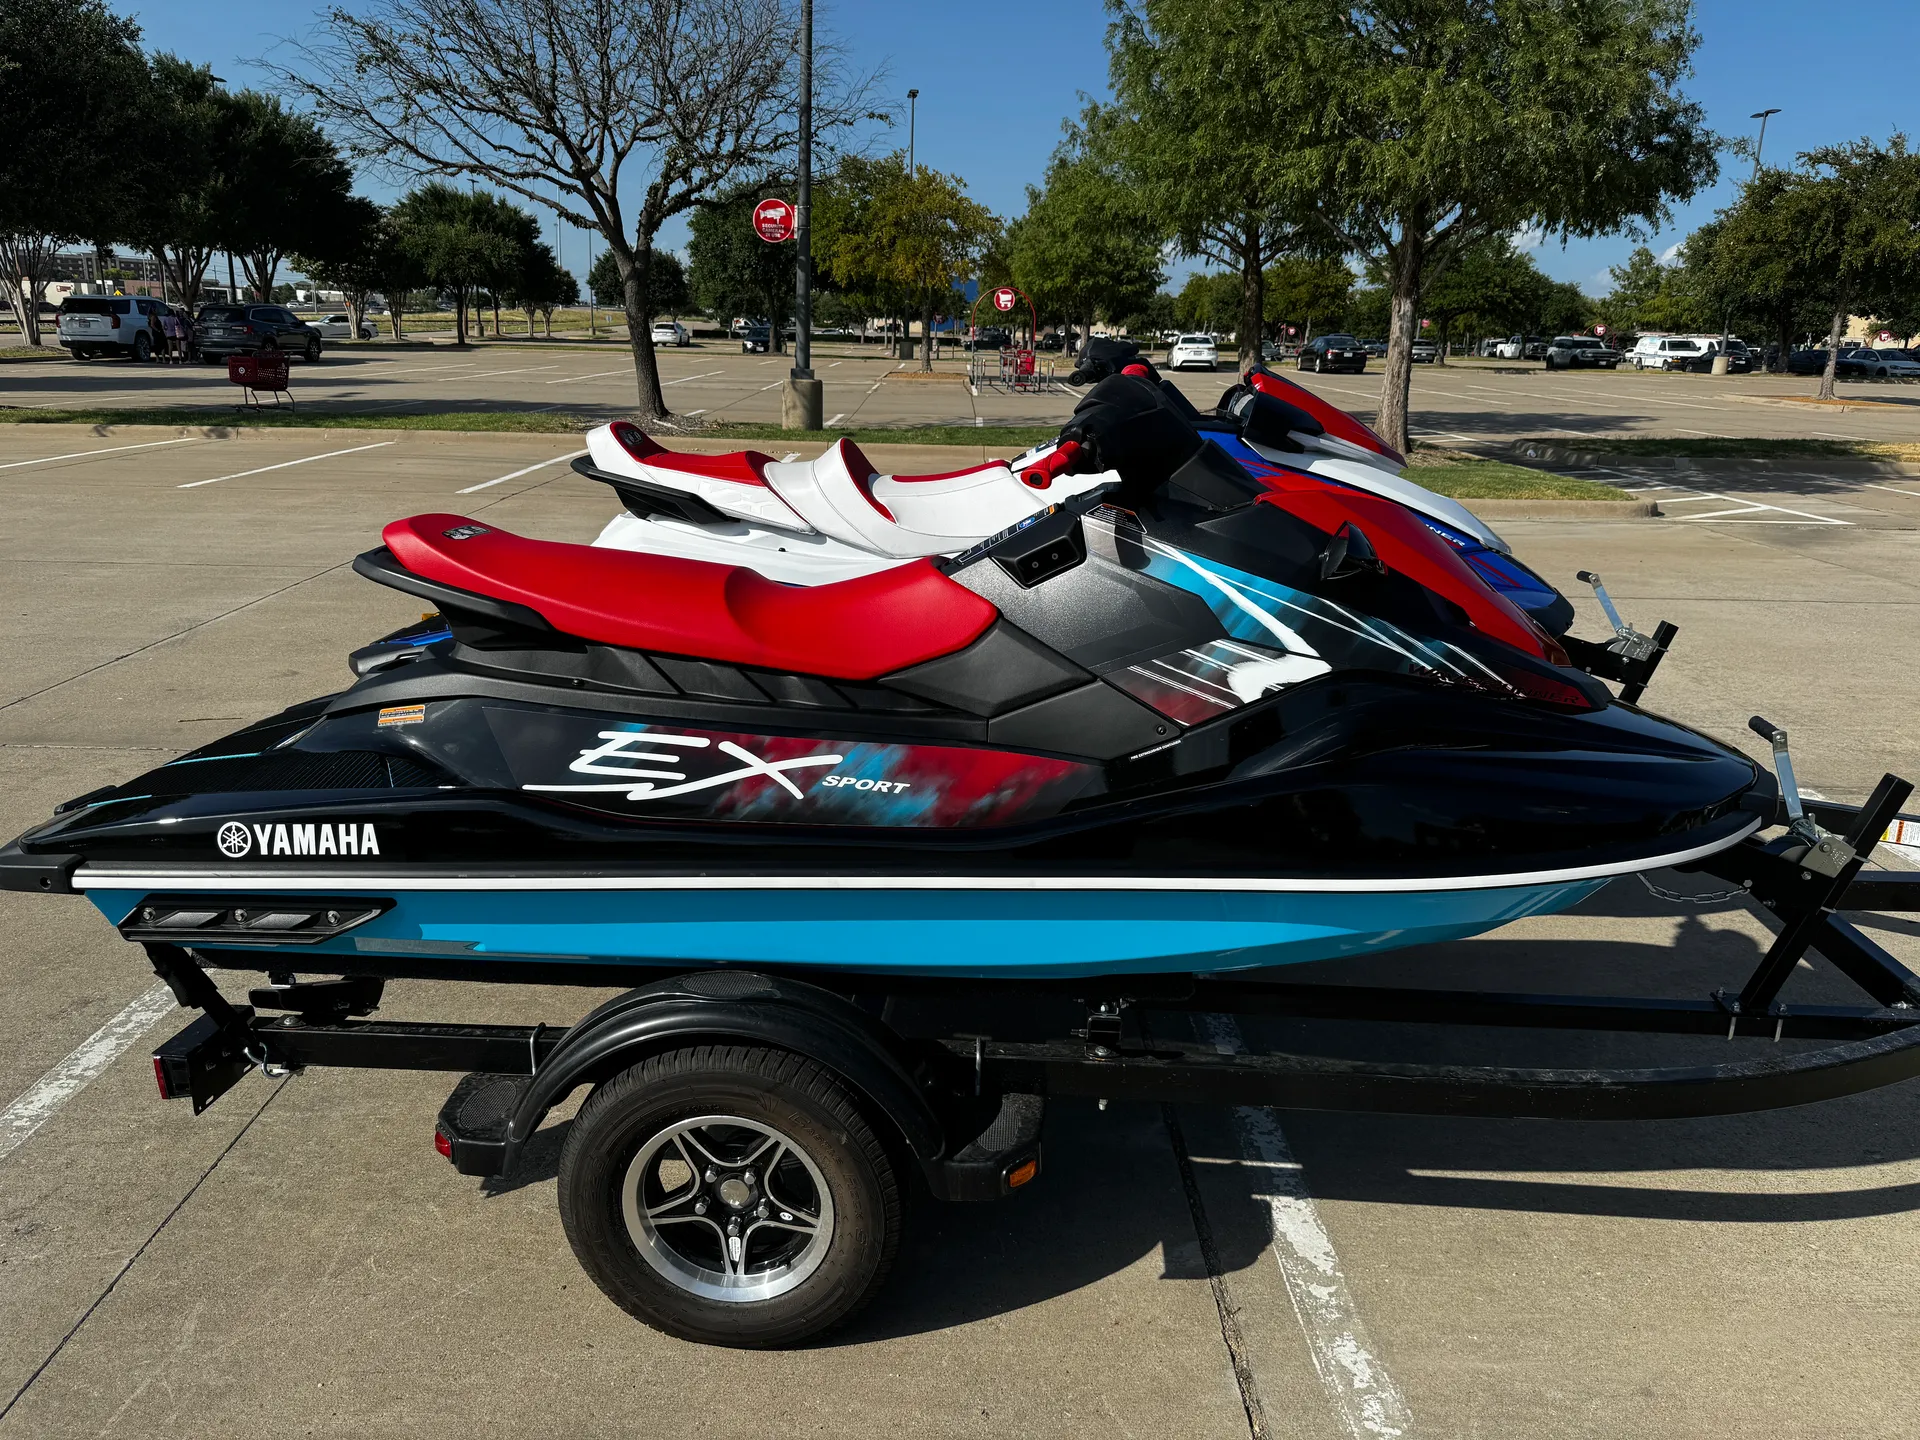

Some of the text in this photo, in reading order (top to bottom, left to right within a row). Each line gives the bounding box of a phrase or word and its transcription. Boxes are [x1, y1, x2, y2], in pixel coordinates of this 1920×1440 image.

[522, 731, 911, 801] EX SPORT
[253, 823, 380, 856] YAMAHA
